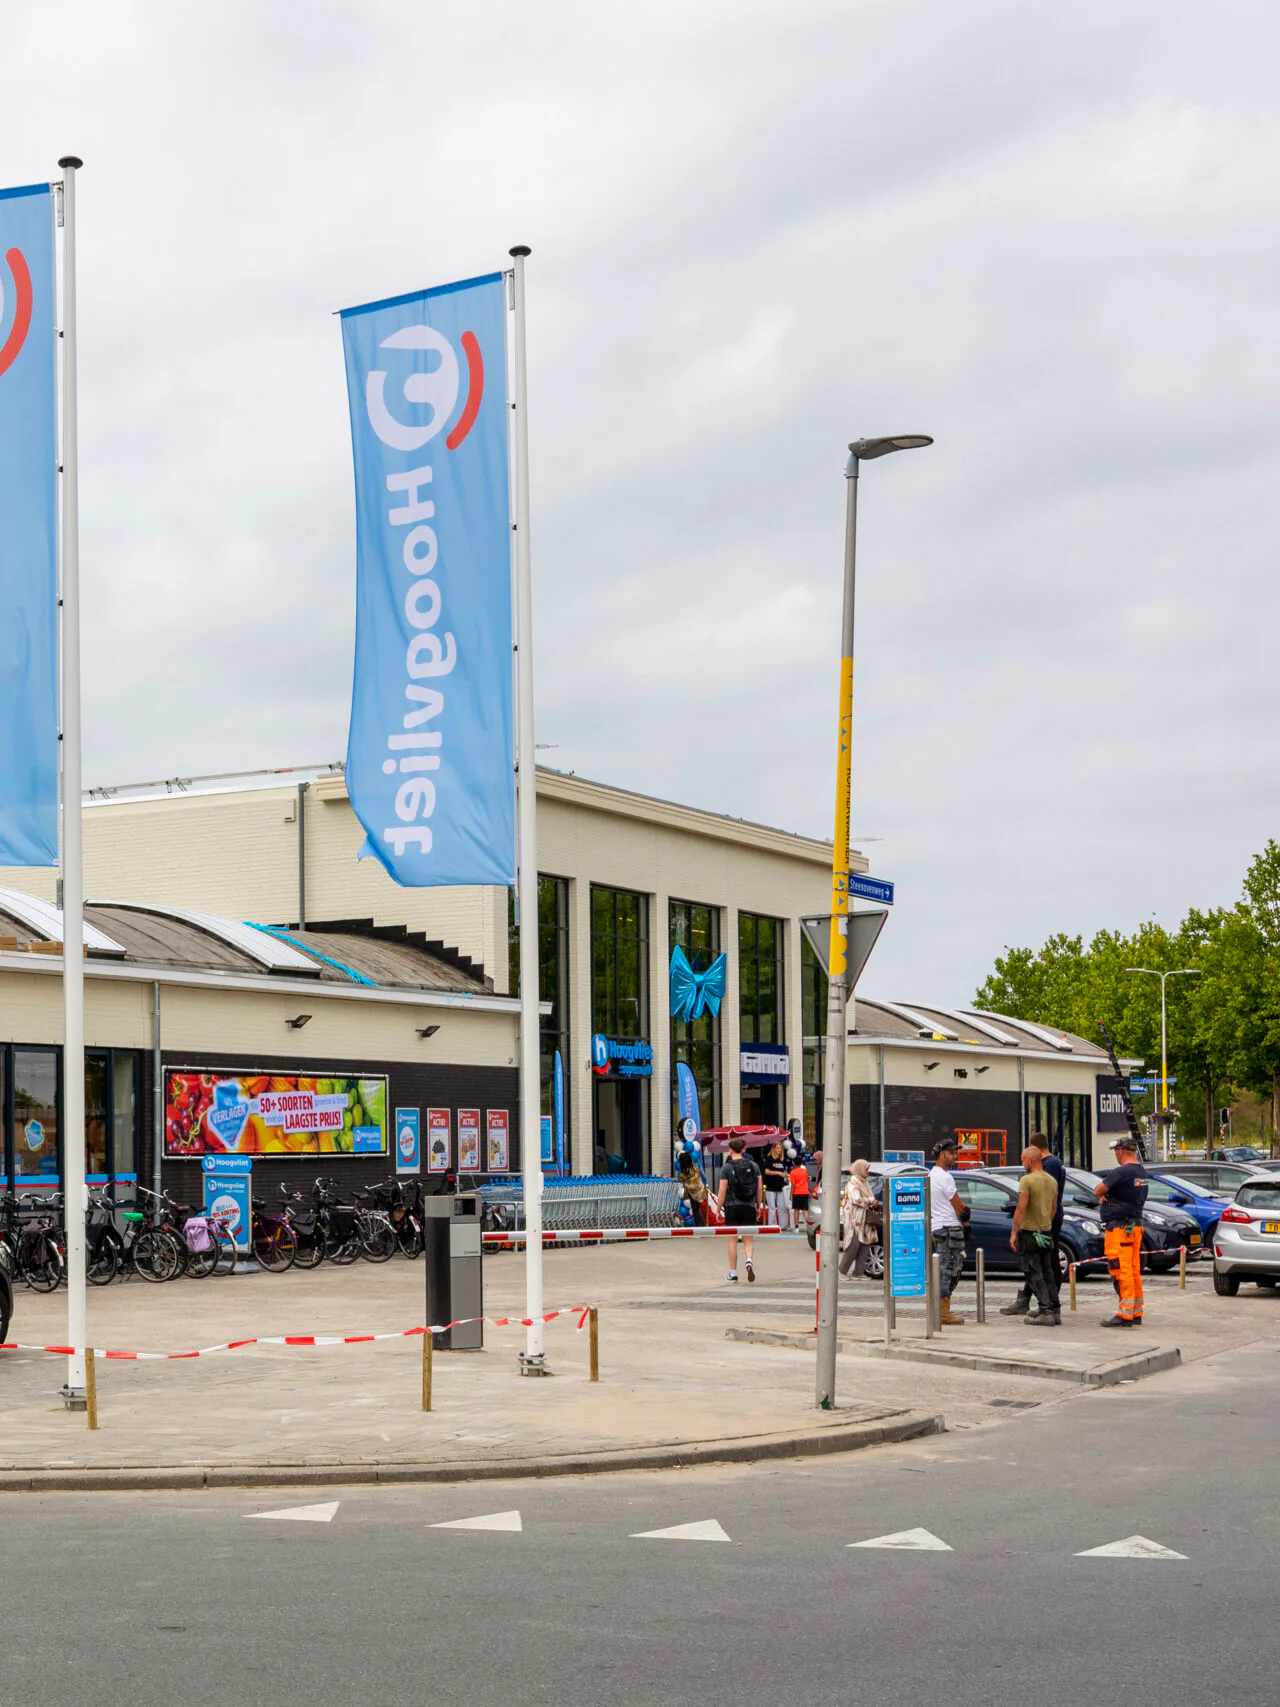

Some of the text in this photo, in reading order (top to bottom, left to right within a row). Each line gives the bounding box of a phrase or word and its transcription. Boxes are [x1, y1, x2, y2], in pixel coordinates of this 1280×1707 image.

[609, 1040, 653, 1063] Hoogvliet
[260, 1098, 277, 1113] 50+
[278, 1095, 313, 1112] SOORTEN
[284, 1112, 318, 1130] LAAGSTE
[319, 1111, 341, 1126] PRIJS!
[216, 1158, 248, 1167] Hoogvliet
